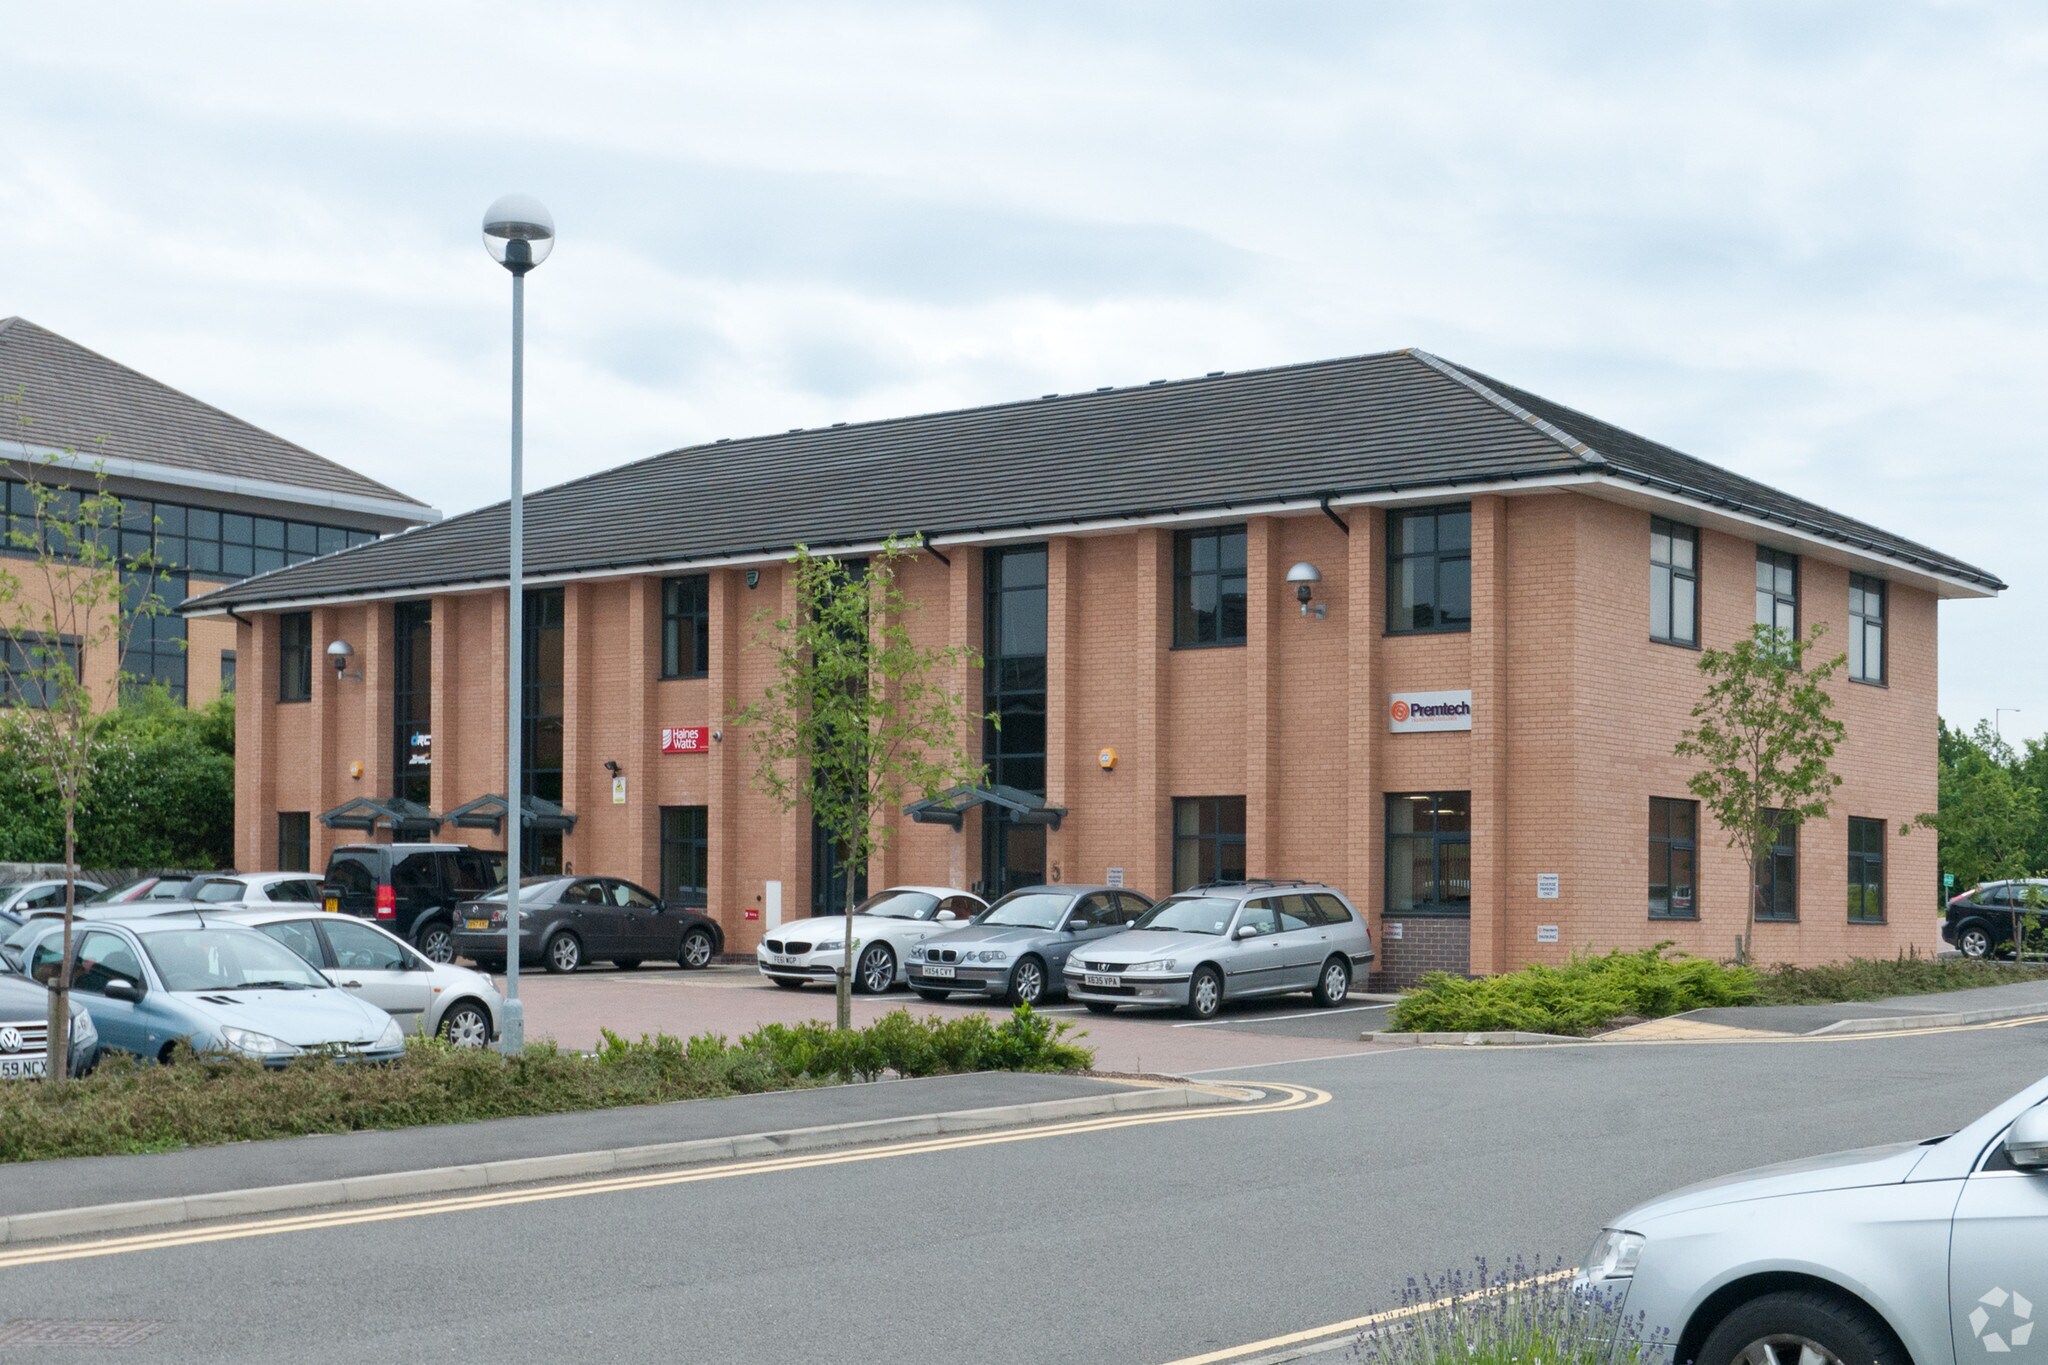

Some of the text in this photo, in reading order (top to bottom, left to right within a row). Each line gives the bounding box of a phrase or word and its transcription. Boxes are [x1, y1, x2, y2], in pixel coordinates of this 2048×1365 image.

[1411, 701, 1470, 716] Premtech
[673, 729, 699, 739] Haines
[673, 739, 697, 749] Watts
